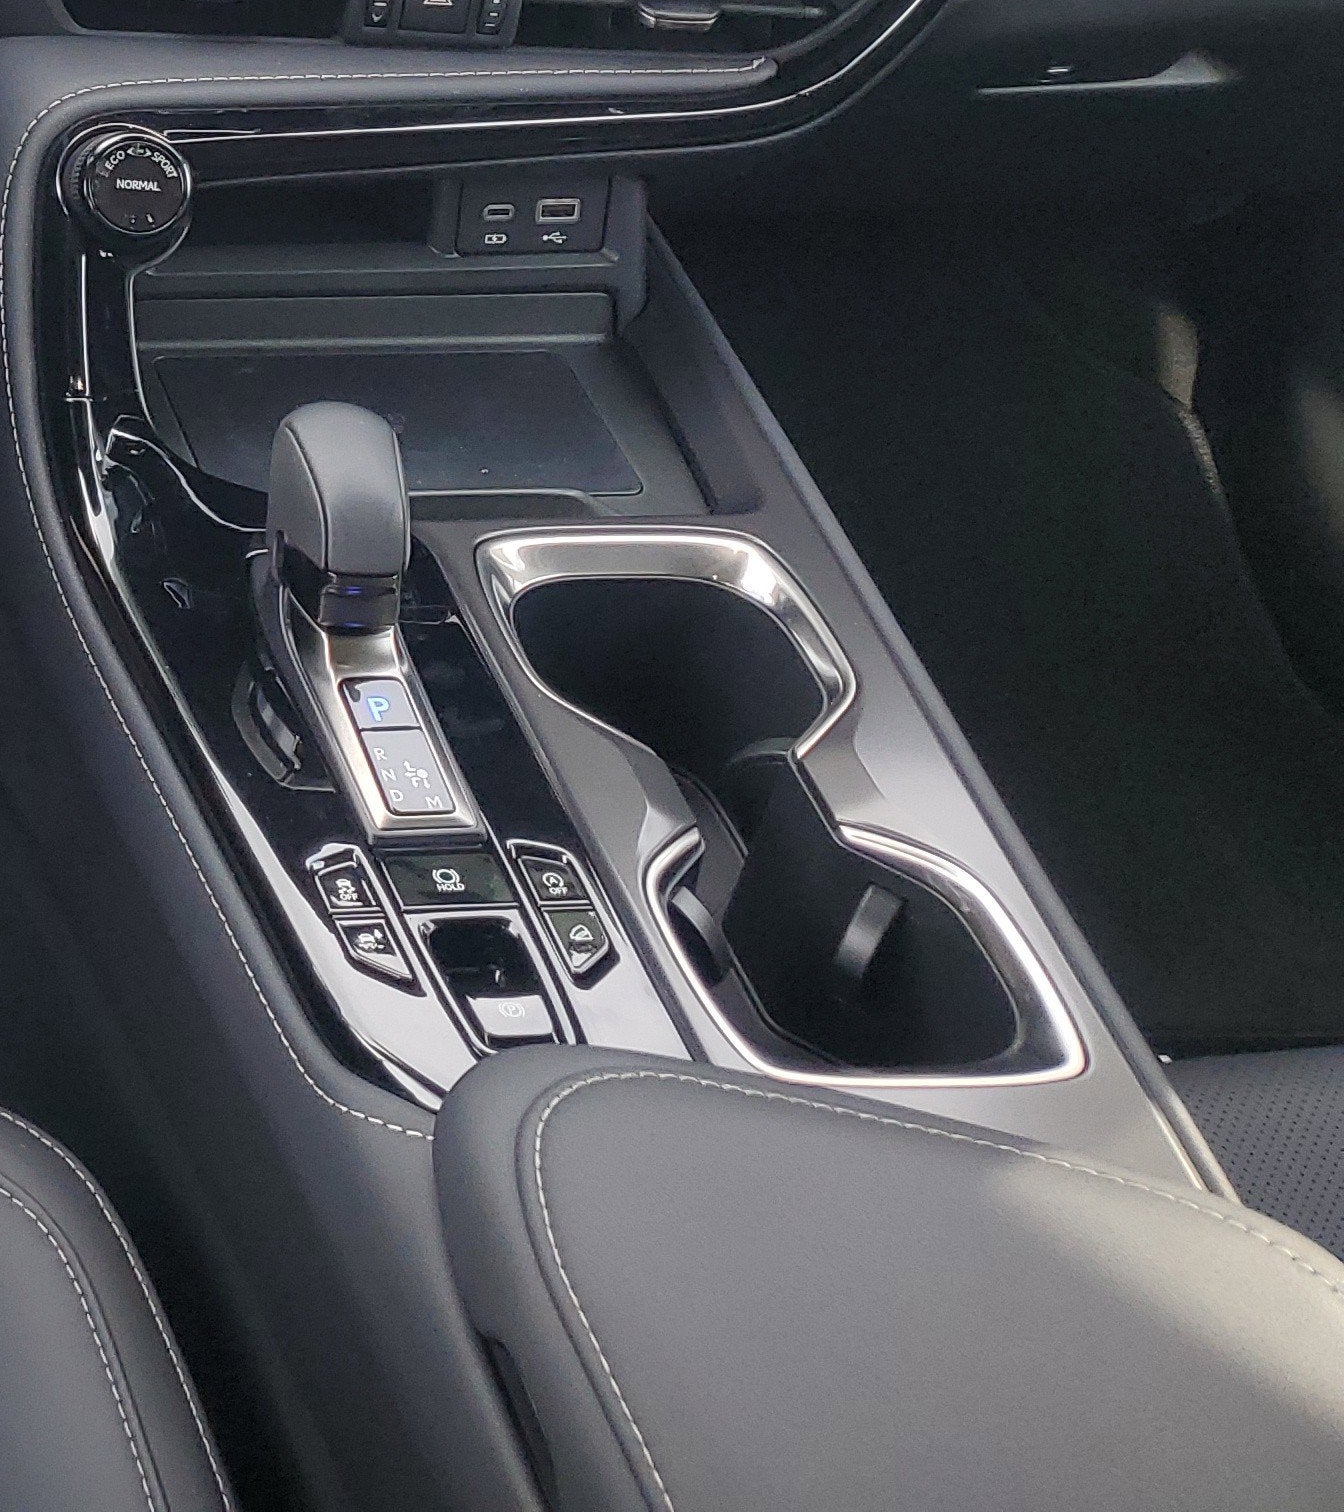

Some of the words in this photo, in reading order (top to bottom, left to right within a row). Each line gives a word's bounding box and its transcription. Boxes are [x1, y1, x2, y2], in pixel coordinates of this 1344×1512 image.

[104, 150, 126, 171] ECO
[151, 151, 179, 178] SPORT
[116, 178, 162, 192] NORMAL
[367, 696, 390, 722] P
[373, 747, 387, 761] R
[380, 768, 398, 782] N
[389, 789, 404, 803] D
[425, 795, 443, 809] M
[436, 882, 465, 892] HOLD
[549, 886, 568, 895] OFF
[340, 892, 359, 901] OFF
